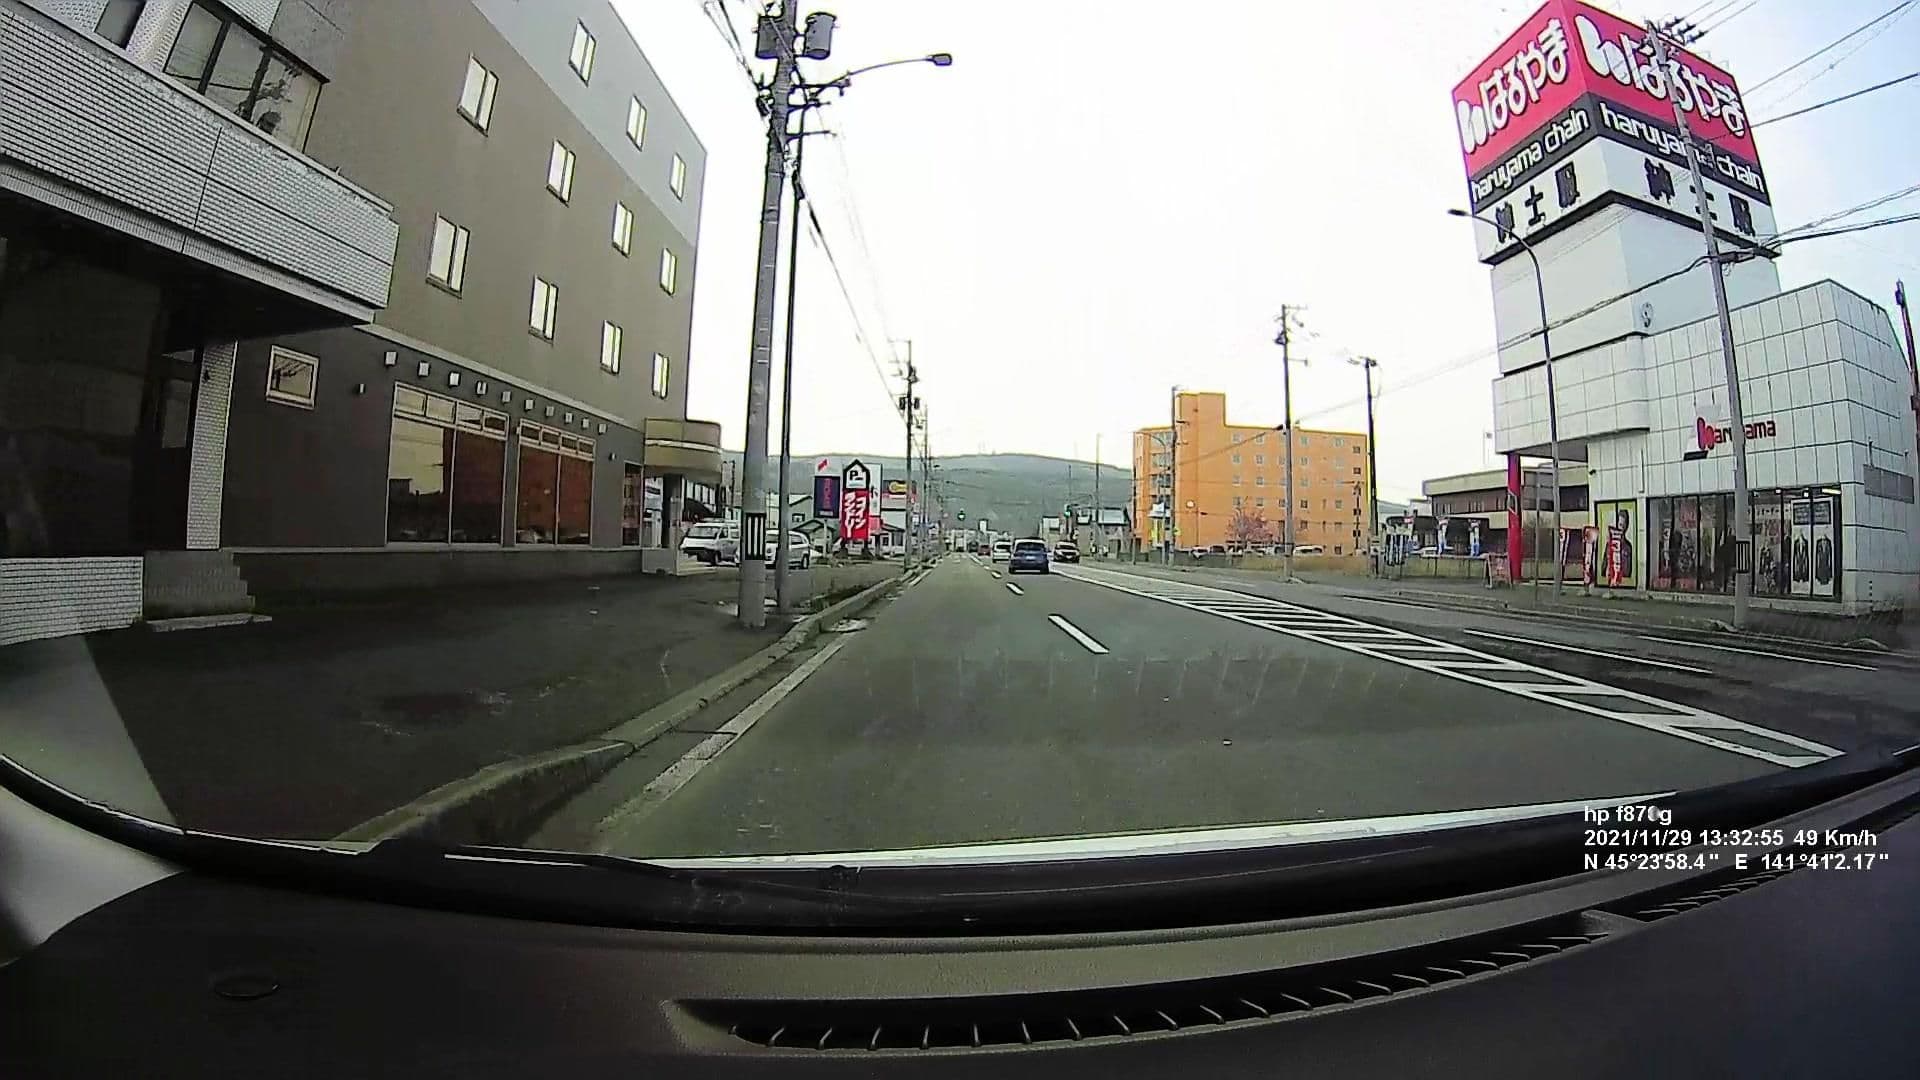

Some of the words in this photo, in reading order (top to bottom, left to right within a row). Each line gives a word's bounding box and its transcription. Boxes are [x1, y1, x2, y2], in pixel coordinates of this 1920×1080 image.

[1479, 18, 1568, 136] はるやま
[1471, 142, 1542, 203] haruyama
[1545, 109, 1588, 153] chain
[1716, 153, 1765, 193] chain
